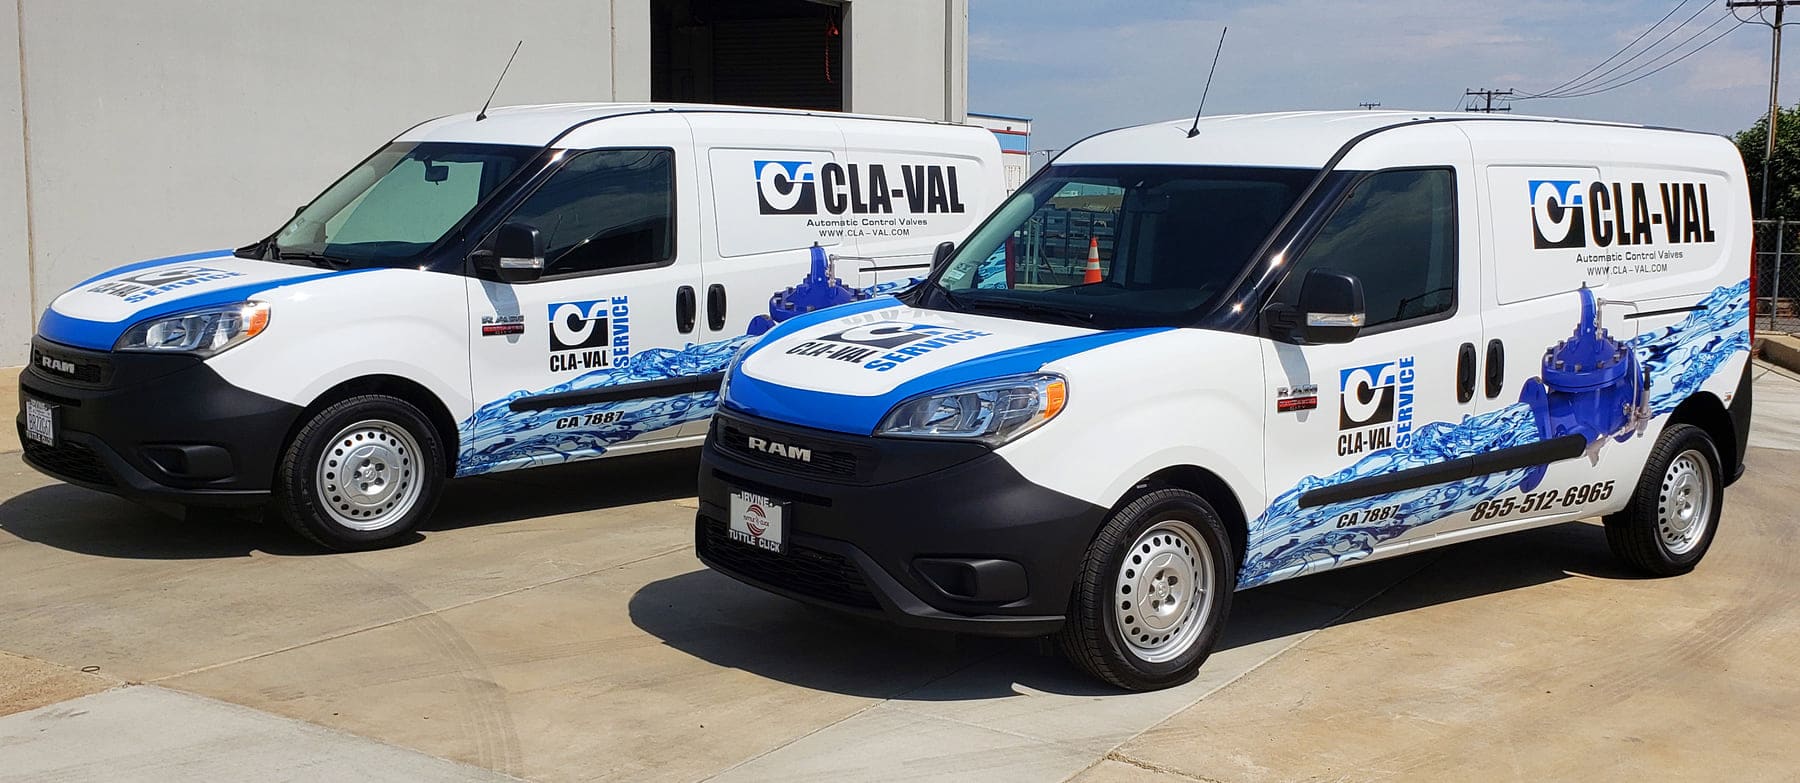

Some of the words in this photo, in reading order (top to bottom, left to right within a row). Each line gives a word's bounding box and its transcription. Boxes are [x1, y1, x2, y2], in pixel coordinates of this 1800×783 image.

[821, 162, 965, 215] CLA-VAL
[806, 218, 858, 227] Automatic
[861, 218, 897, 226] Control
[899, 217, 928, 226] Valves
[1588, 180, 1715, 248] CLA-VAL
[1576, 252, 1622, 263] Automatic
[1625, 251, 1656, 261] Control
[1658, 250, 1683, 259] Valves
[123, 271, 247, 304] SERVICE
[612, 295, 629, 369] SERVICE
[550, 350, 608, 372] CLA-VAL
[786, 341, 879, 363] CLA-VAL
[863, 329, 993, 372] SERVICE
[42, 356, 75, 374] RAM
[1396, 356, 1415, 449] SERVICE
[556, 416, 579, 430] CA
[584, 410, 625, 426] 7887
[748, 436, 812, 462] RAM
[1338, 426, 1392, 456] CLA-VAL
[741, 490, 770, 507] IRVINE
[1470, 480, 1616, 522] 855-512-6965
[1336, 512, 1359, 528] CA
[1361, 504, 1400, 524] 7887
[728, 529, 756, 546] TUTTLE
[758, 537, 780, 553] CLICK
